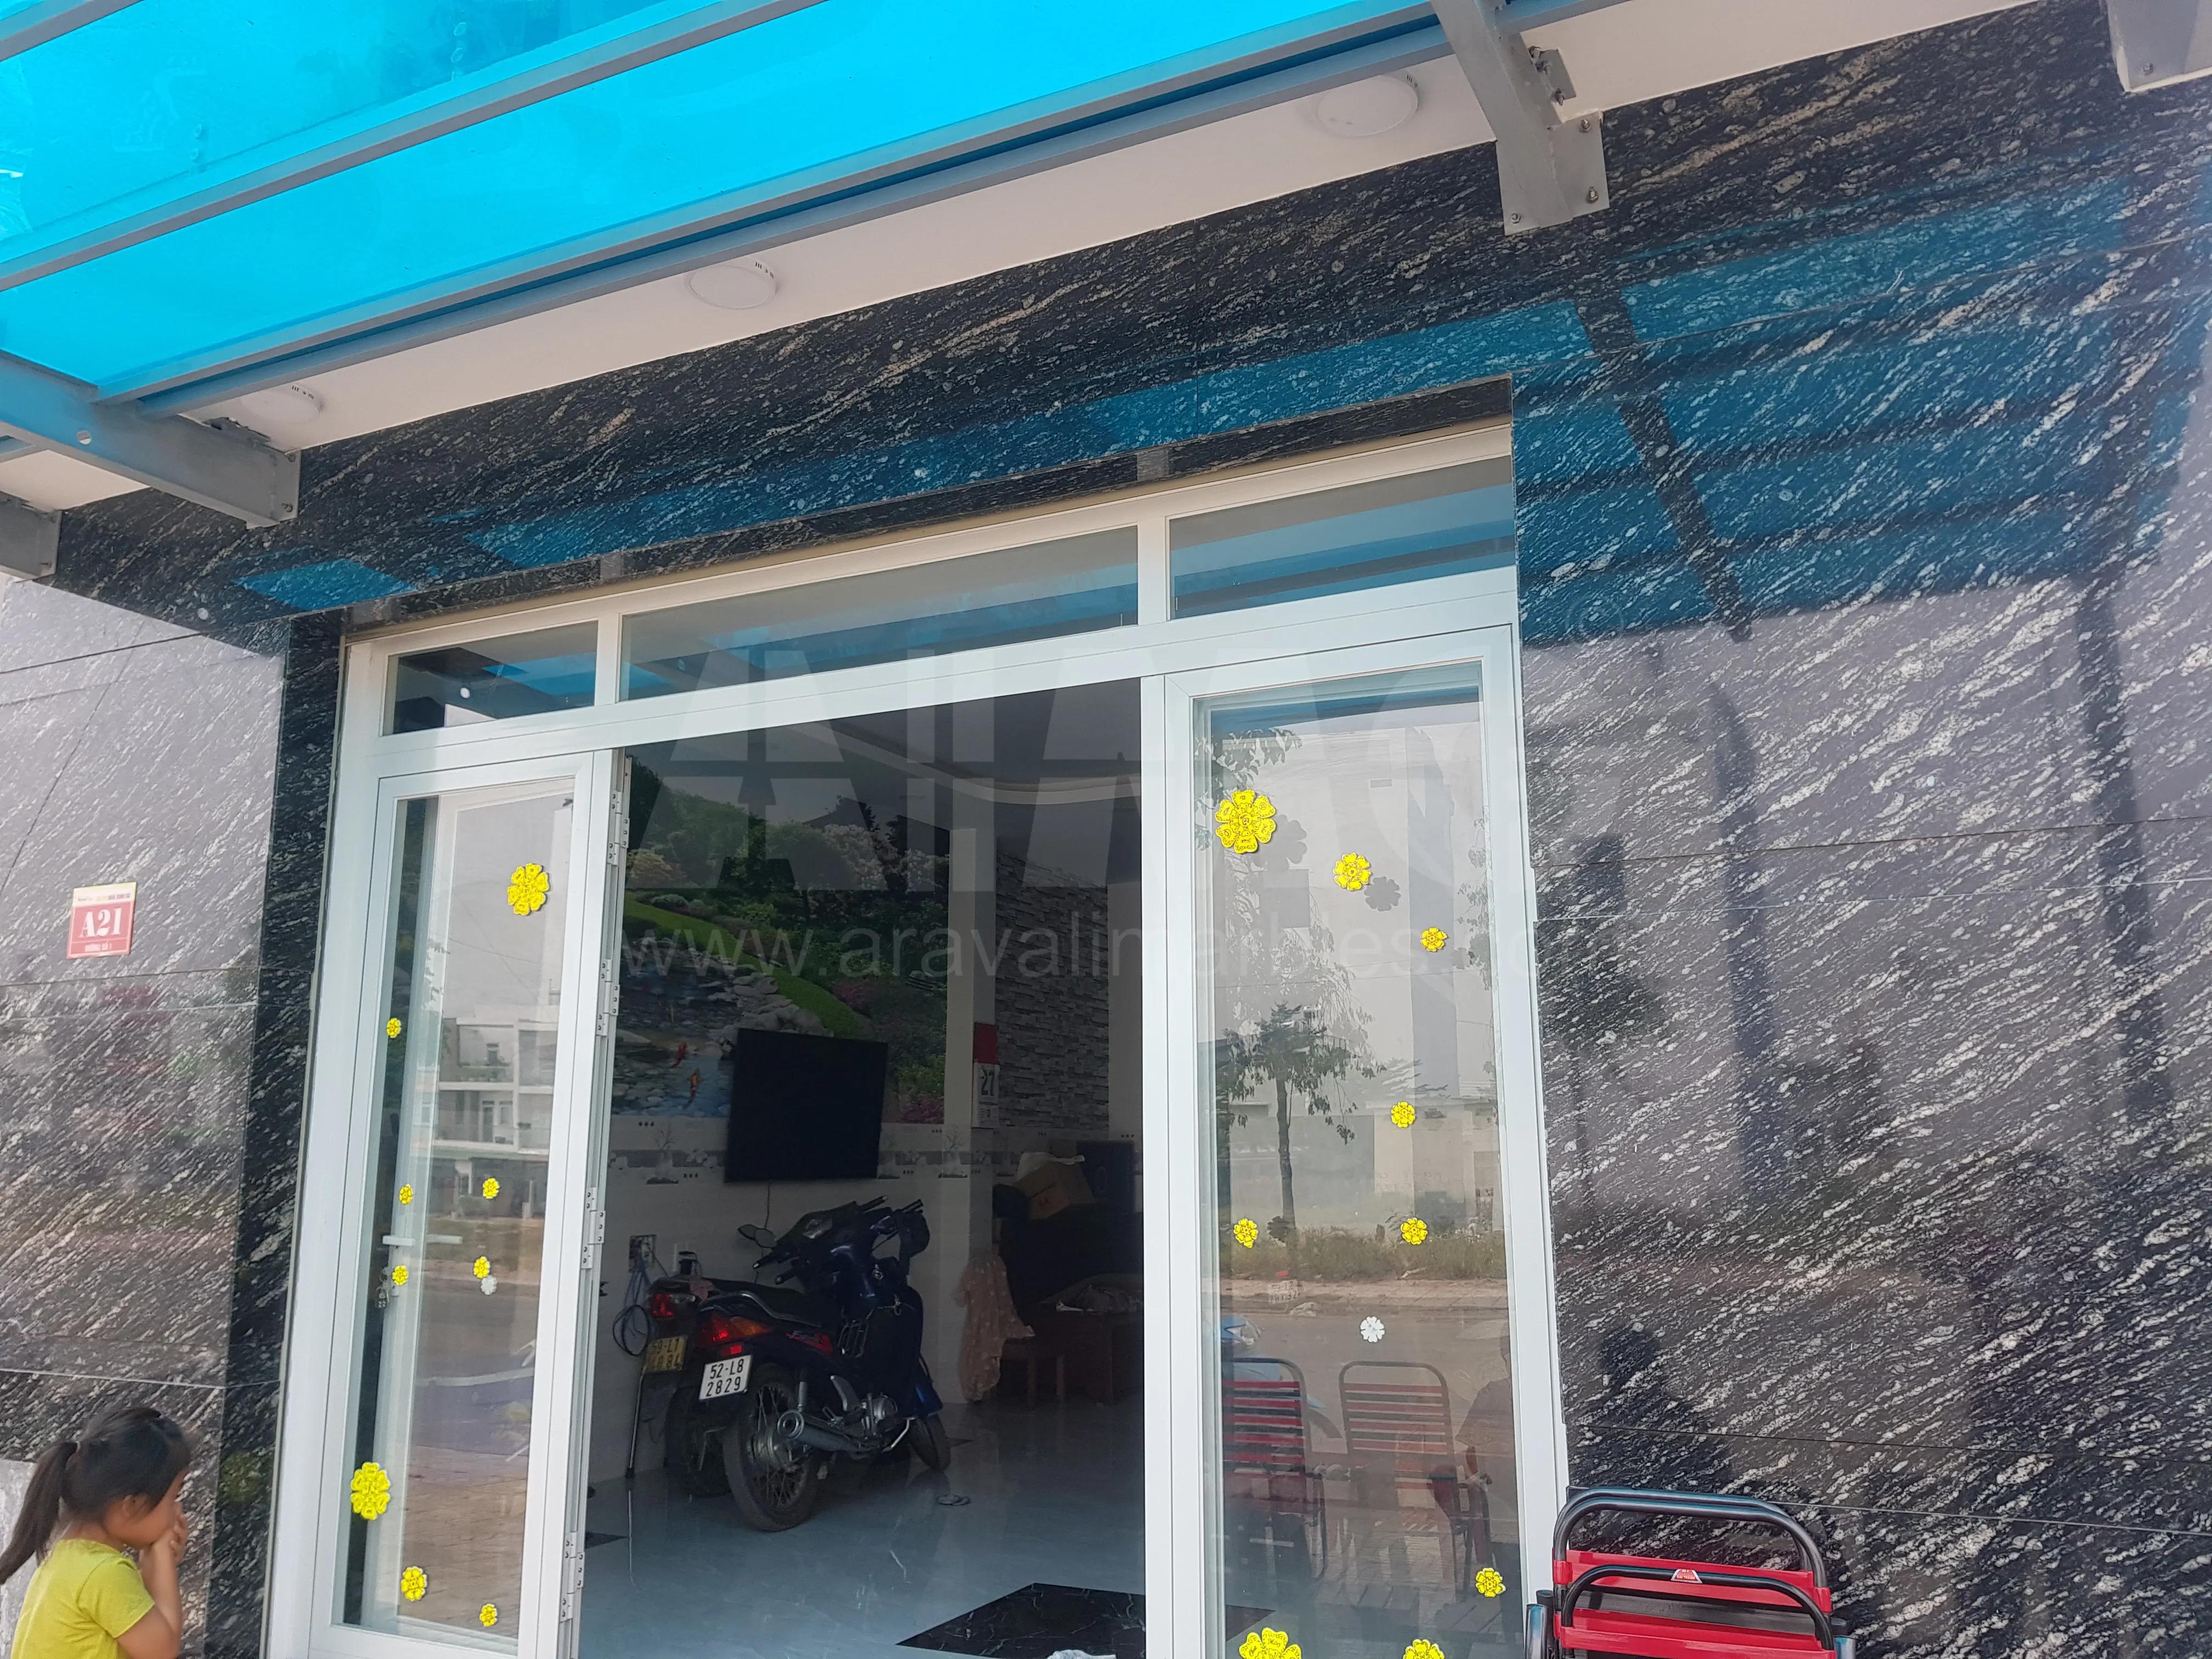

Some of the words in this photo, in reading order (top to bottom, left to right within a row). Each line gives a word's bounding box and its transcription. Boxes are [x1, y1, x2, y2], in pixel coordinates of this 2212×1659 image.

[79, 907, 123, 938] A21
[710, 1358, 744, 1379] 52-L8
[706, 1376, 741, 1397] 2829
